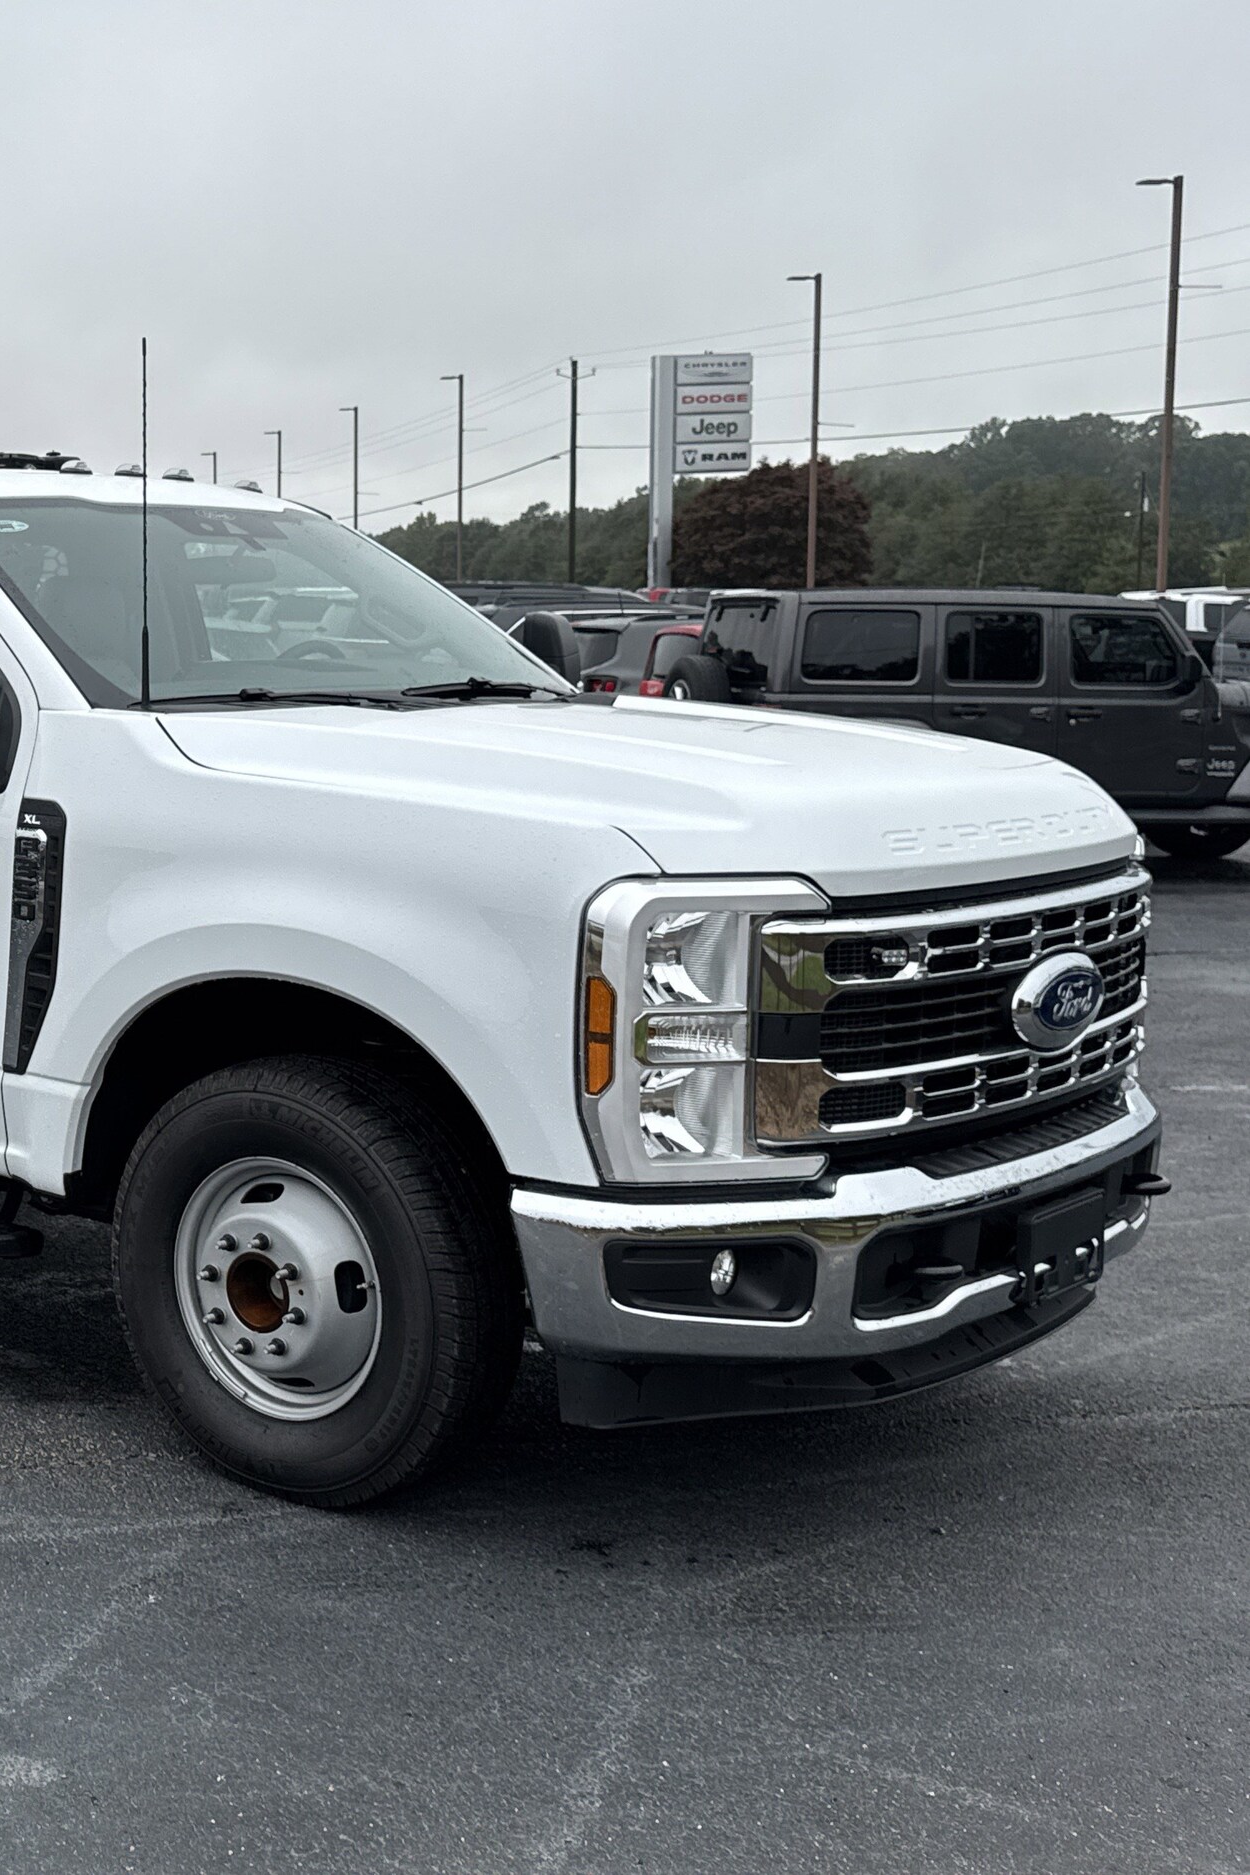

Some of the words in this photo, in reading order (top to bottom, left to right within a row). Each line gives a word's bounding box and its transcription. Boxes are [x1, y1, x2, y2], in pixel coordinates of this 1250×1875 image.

[681, 393, 748, 405] DODGE
[691, 418, 739, 438] Jeep
[701, 451, 747, 462] RAM
[23, 813, 41, 825] XL
[1053, 979, 1093, 1022] Ford
[275, 1105, 382, 1190] MICHELIN
